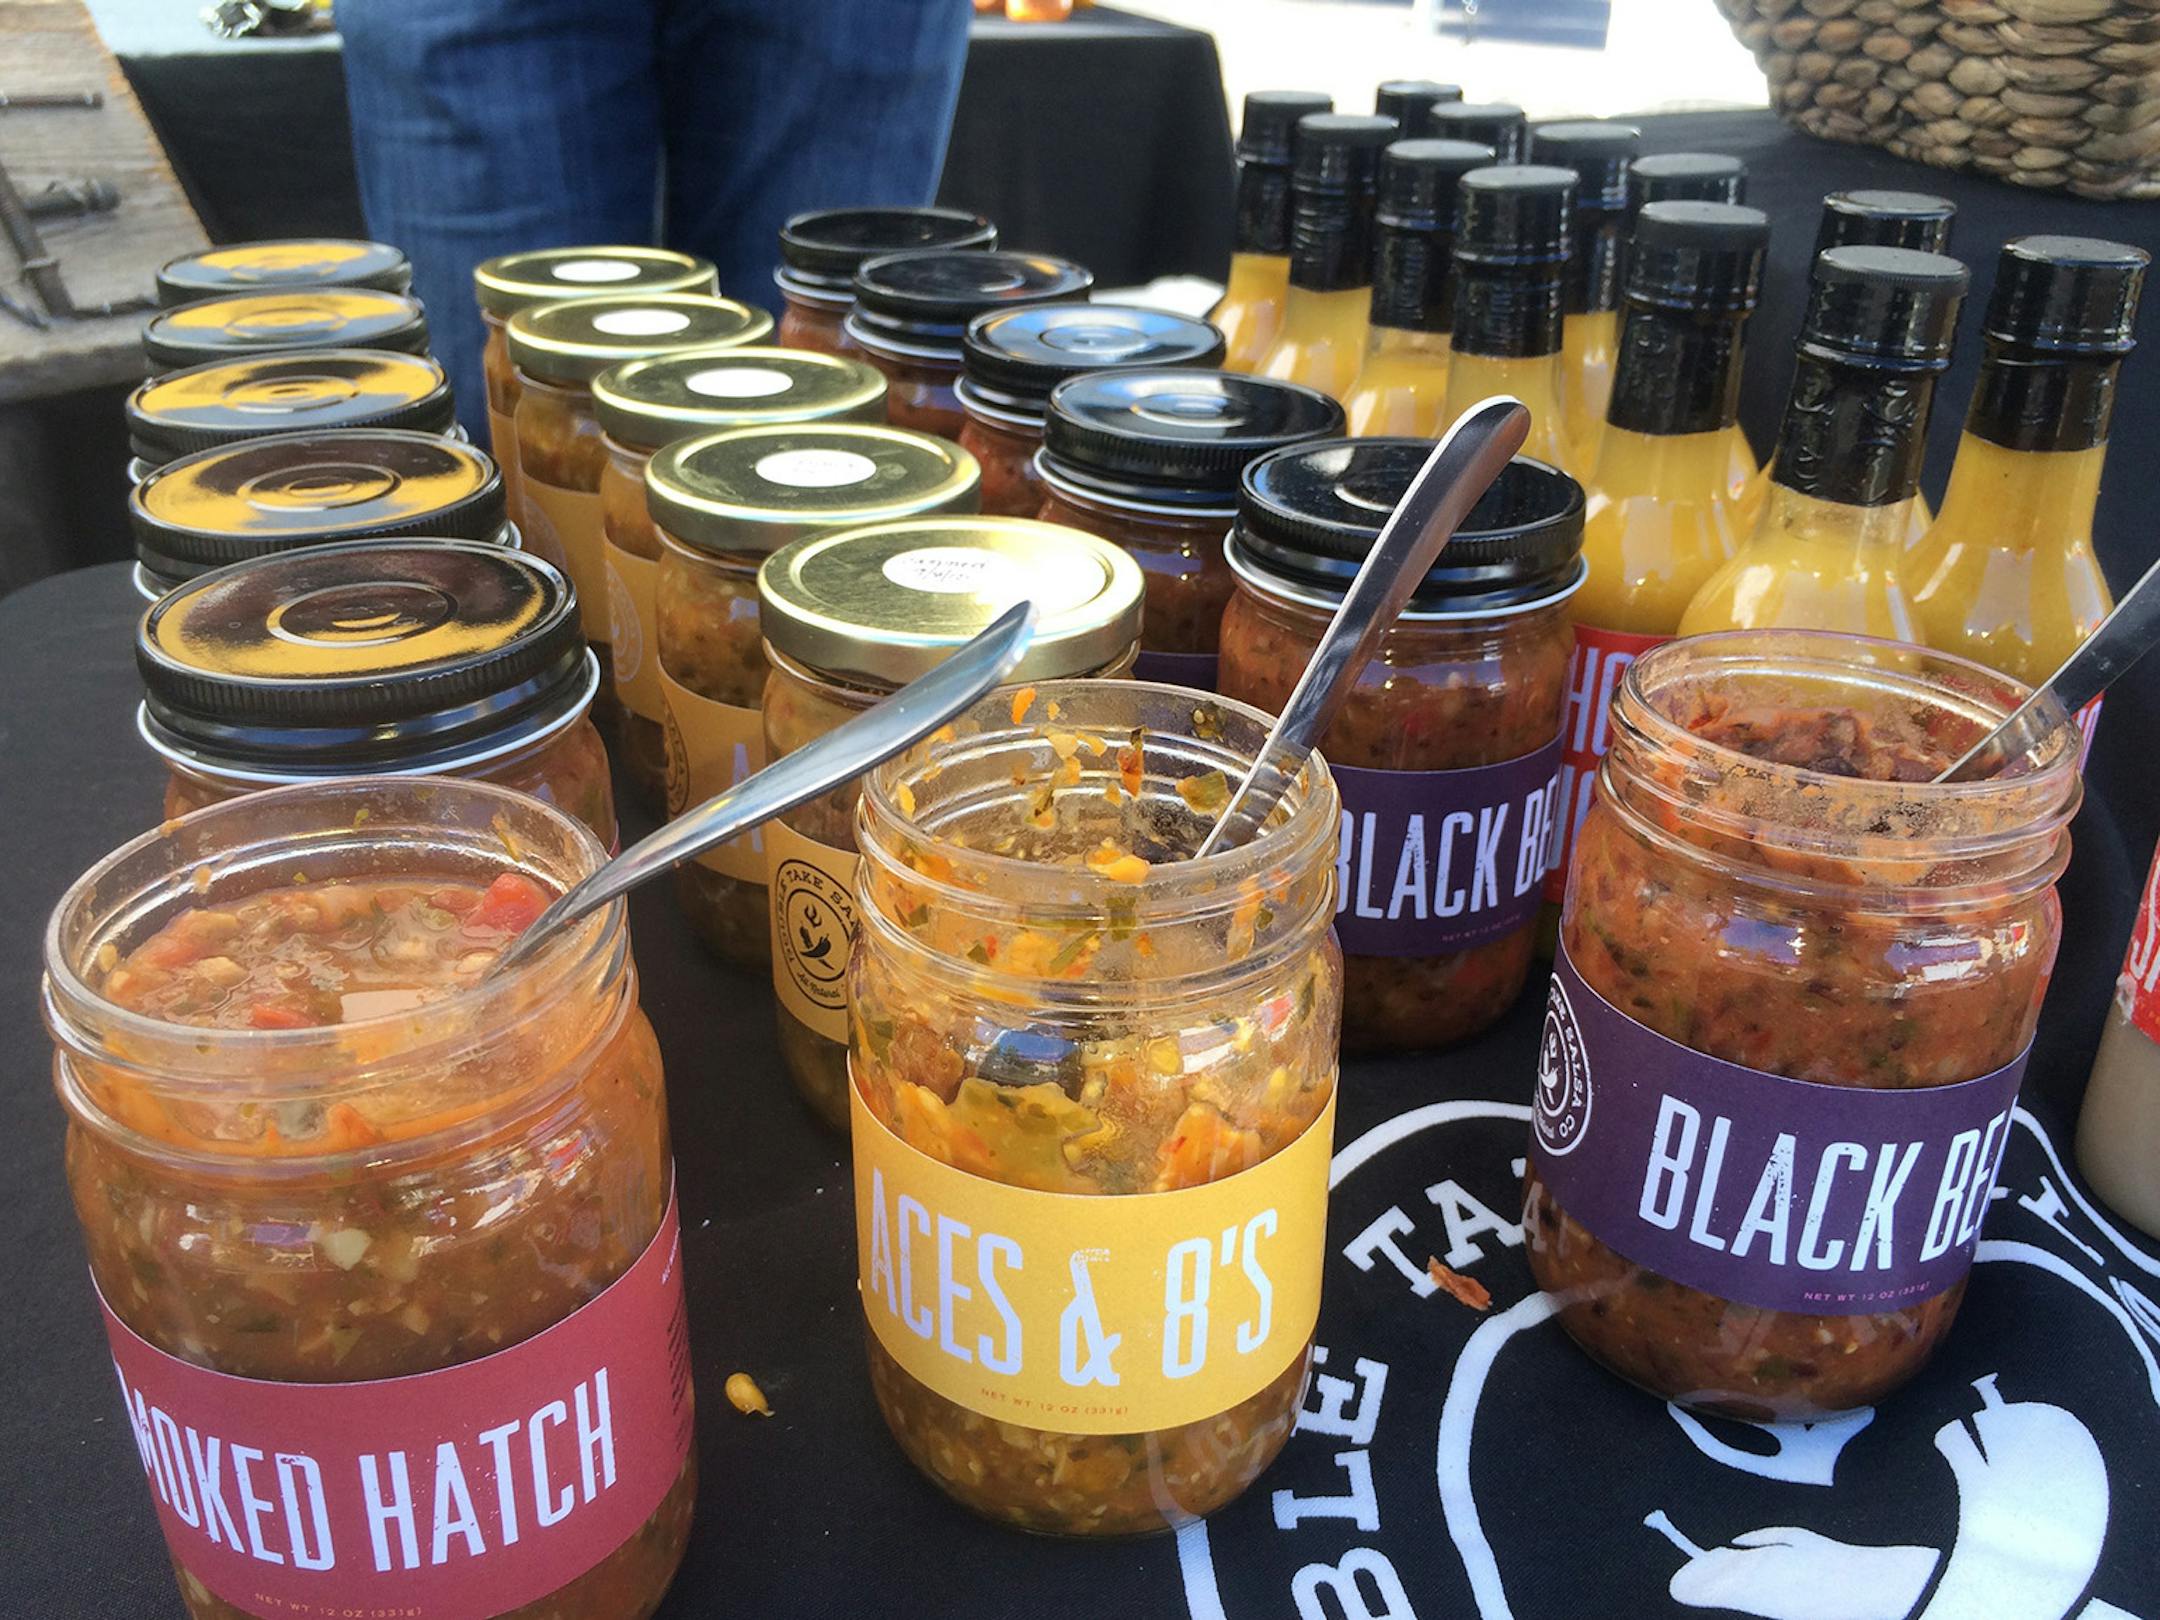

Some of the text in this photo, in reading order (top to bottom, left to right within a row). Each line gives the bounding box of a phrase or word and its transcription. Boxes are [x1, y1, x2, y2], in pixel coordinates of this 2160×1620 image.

[1638, 1094, 1924, 1272] BLACK
[1919, 1095, 2018, 1262] BE
[871, 1168, 1023, 1378] ACES
[1058, 1248, 1121, 1387] &
[1161, 1208, 1277, 1380] 8'S
[1803, 1291, 1831, 1301] NET
[1837, 1293, 1856, 1302] WT
[1862, 1293, 1875, 1301] 12
[1879, 1290, 1895, 1300] OZ
[981, 1387, 1007, 1401] NET
[1013, 1397, 1032, 1408] WT
[1040, 1403, 1055, 1412] 12
[1060, 1405, 1079, 1415] OZ
[358, 1366, 617, 1573] HATCH
[254, 1592, 282, 1606] NET
[289, 1602, 311, 1613] WT
[320, 1607, 336, 1617] 12
[342, 1609, 363, 1618] OZ
